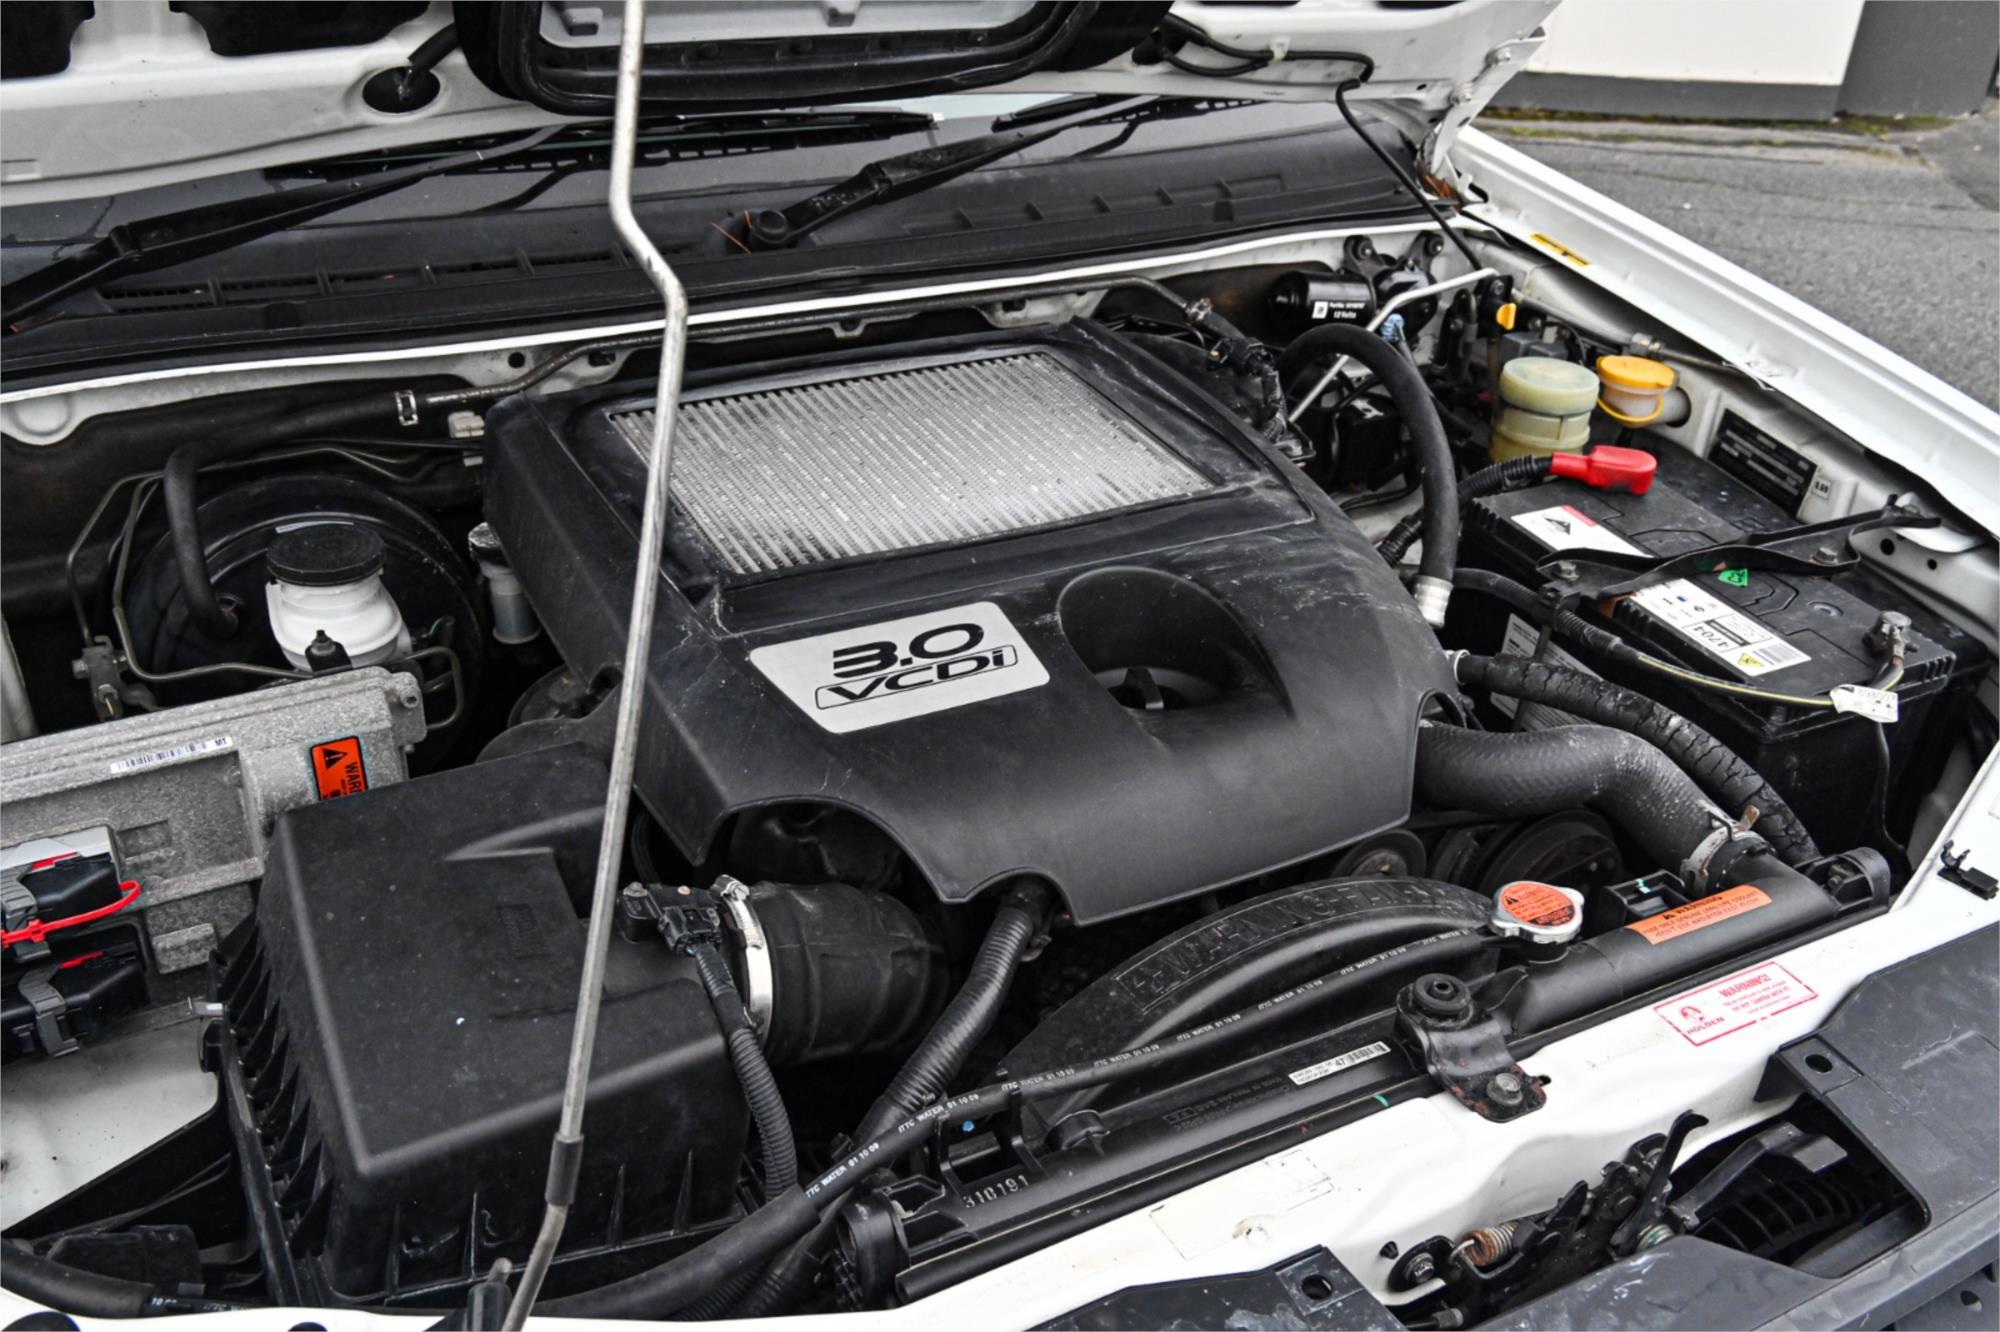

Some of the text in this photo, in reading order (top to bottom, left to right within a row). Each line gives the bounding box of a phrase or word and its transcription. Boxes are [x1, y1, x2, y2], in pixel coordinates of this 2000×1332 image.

[833, 622, 985, 679] 3.0
[1692, 625, 1730, 649] 4704
[826, 649, 1005, 701] VCDi
[1687, 1015, 1725, 1036] HOLDEN
[916, 1105, 944, 1122] WATER
[946, 1100, 957, 1109] 01
[958, 1096, 969, 1105] 10
[821, 1165, 848, 1186] WATER
[848, 1156, 859, 1167] 01
[859, 1149, 869, 1159] 10
[962, 1173, 1029, 1209] 310191
